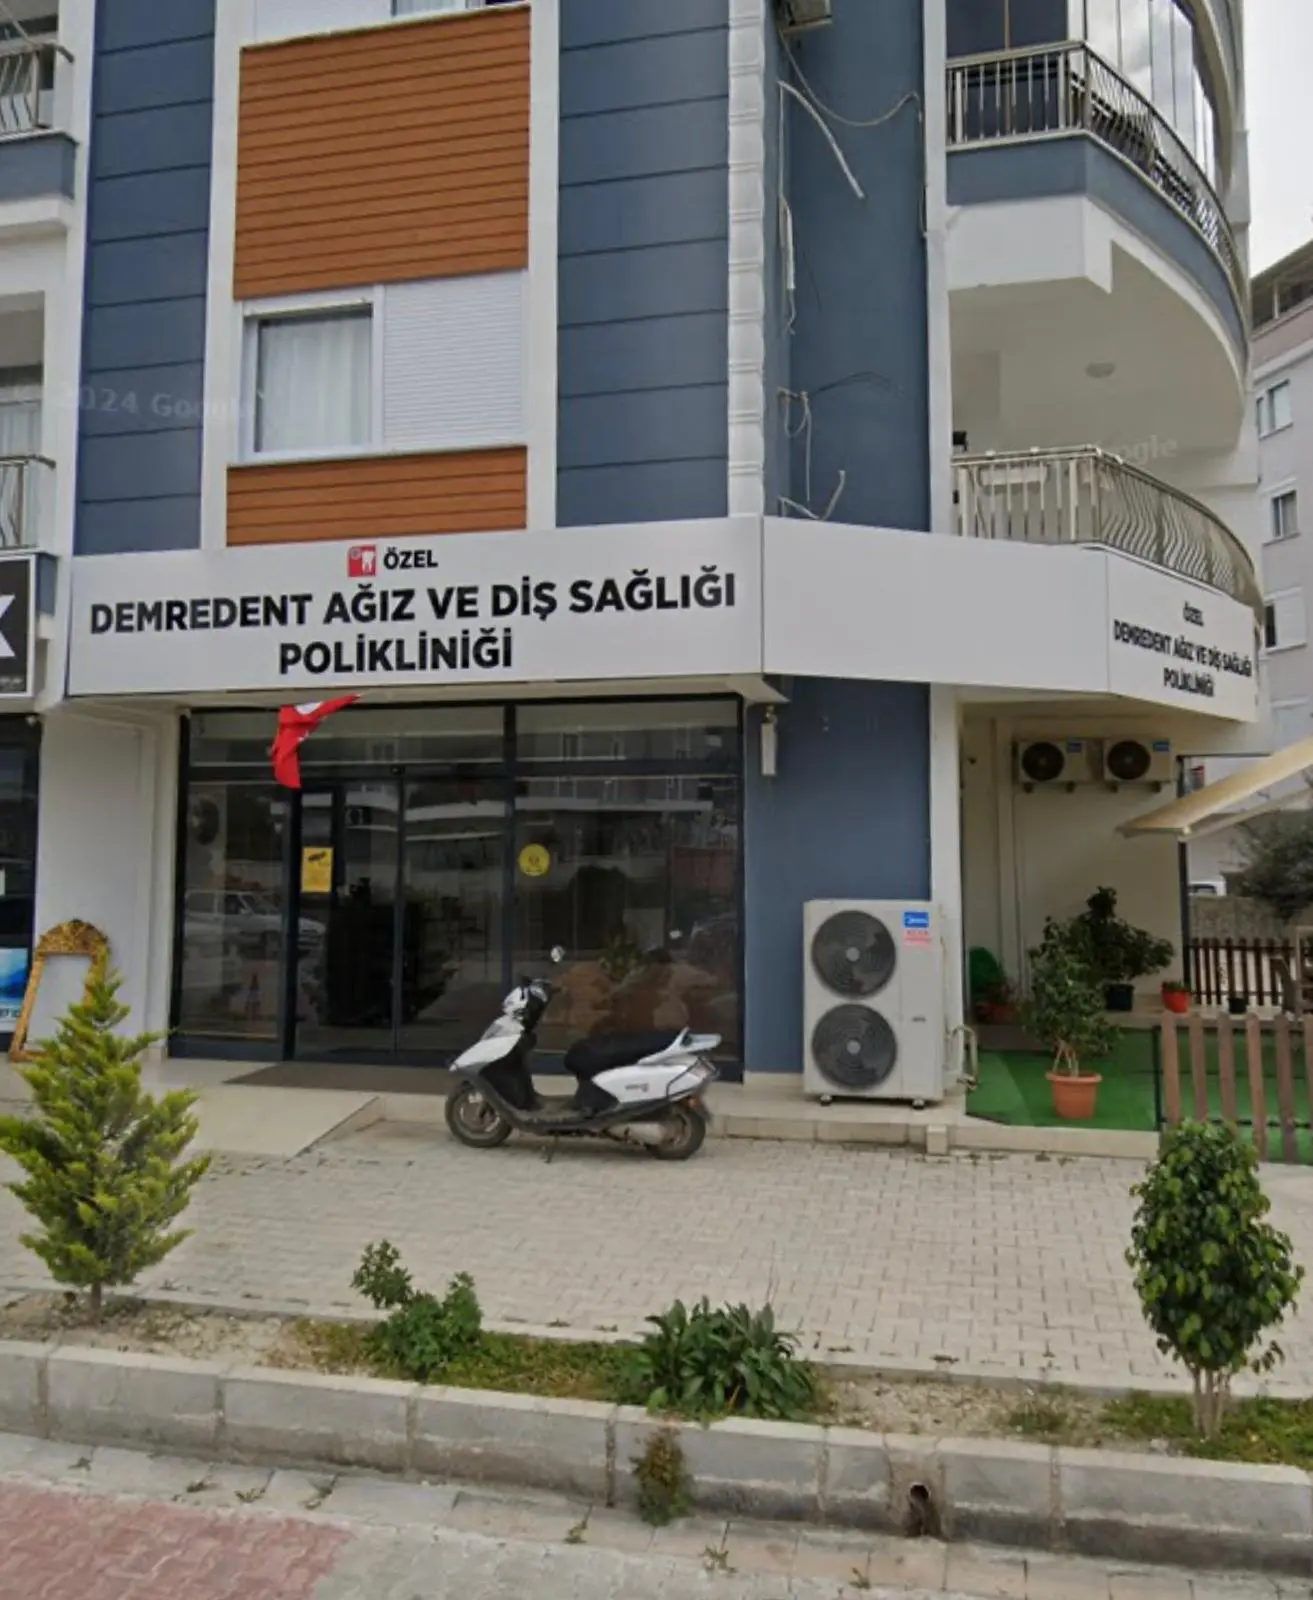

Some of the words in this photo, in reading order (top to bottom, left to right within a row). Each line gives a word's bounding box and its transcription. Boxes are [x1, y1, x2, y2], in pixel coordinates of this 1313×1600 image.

[383, 546, 438, 570] ÖZEL
[91, 594, 312, 634] DEMREDENT
[323, 584, 415, 624] AĞIZ
[427, 586, 479, 619] VE
[491, 576, 557, 621] DİŞ
[569, 565, 735, 614] SAĞLIĞI
[280, 627, 512, 675] POLİKLİNİĞİ
[1113, 619, 1172, 655] DEMREDENT
